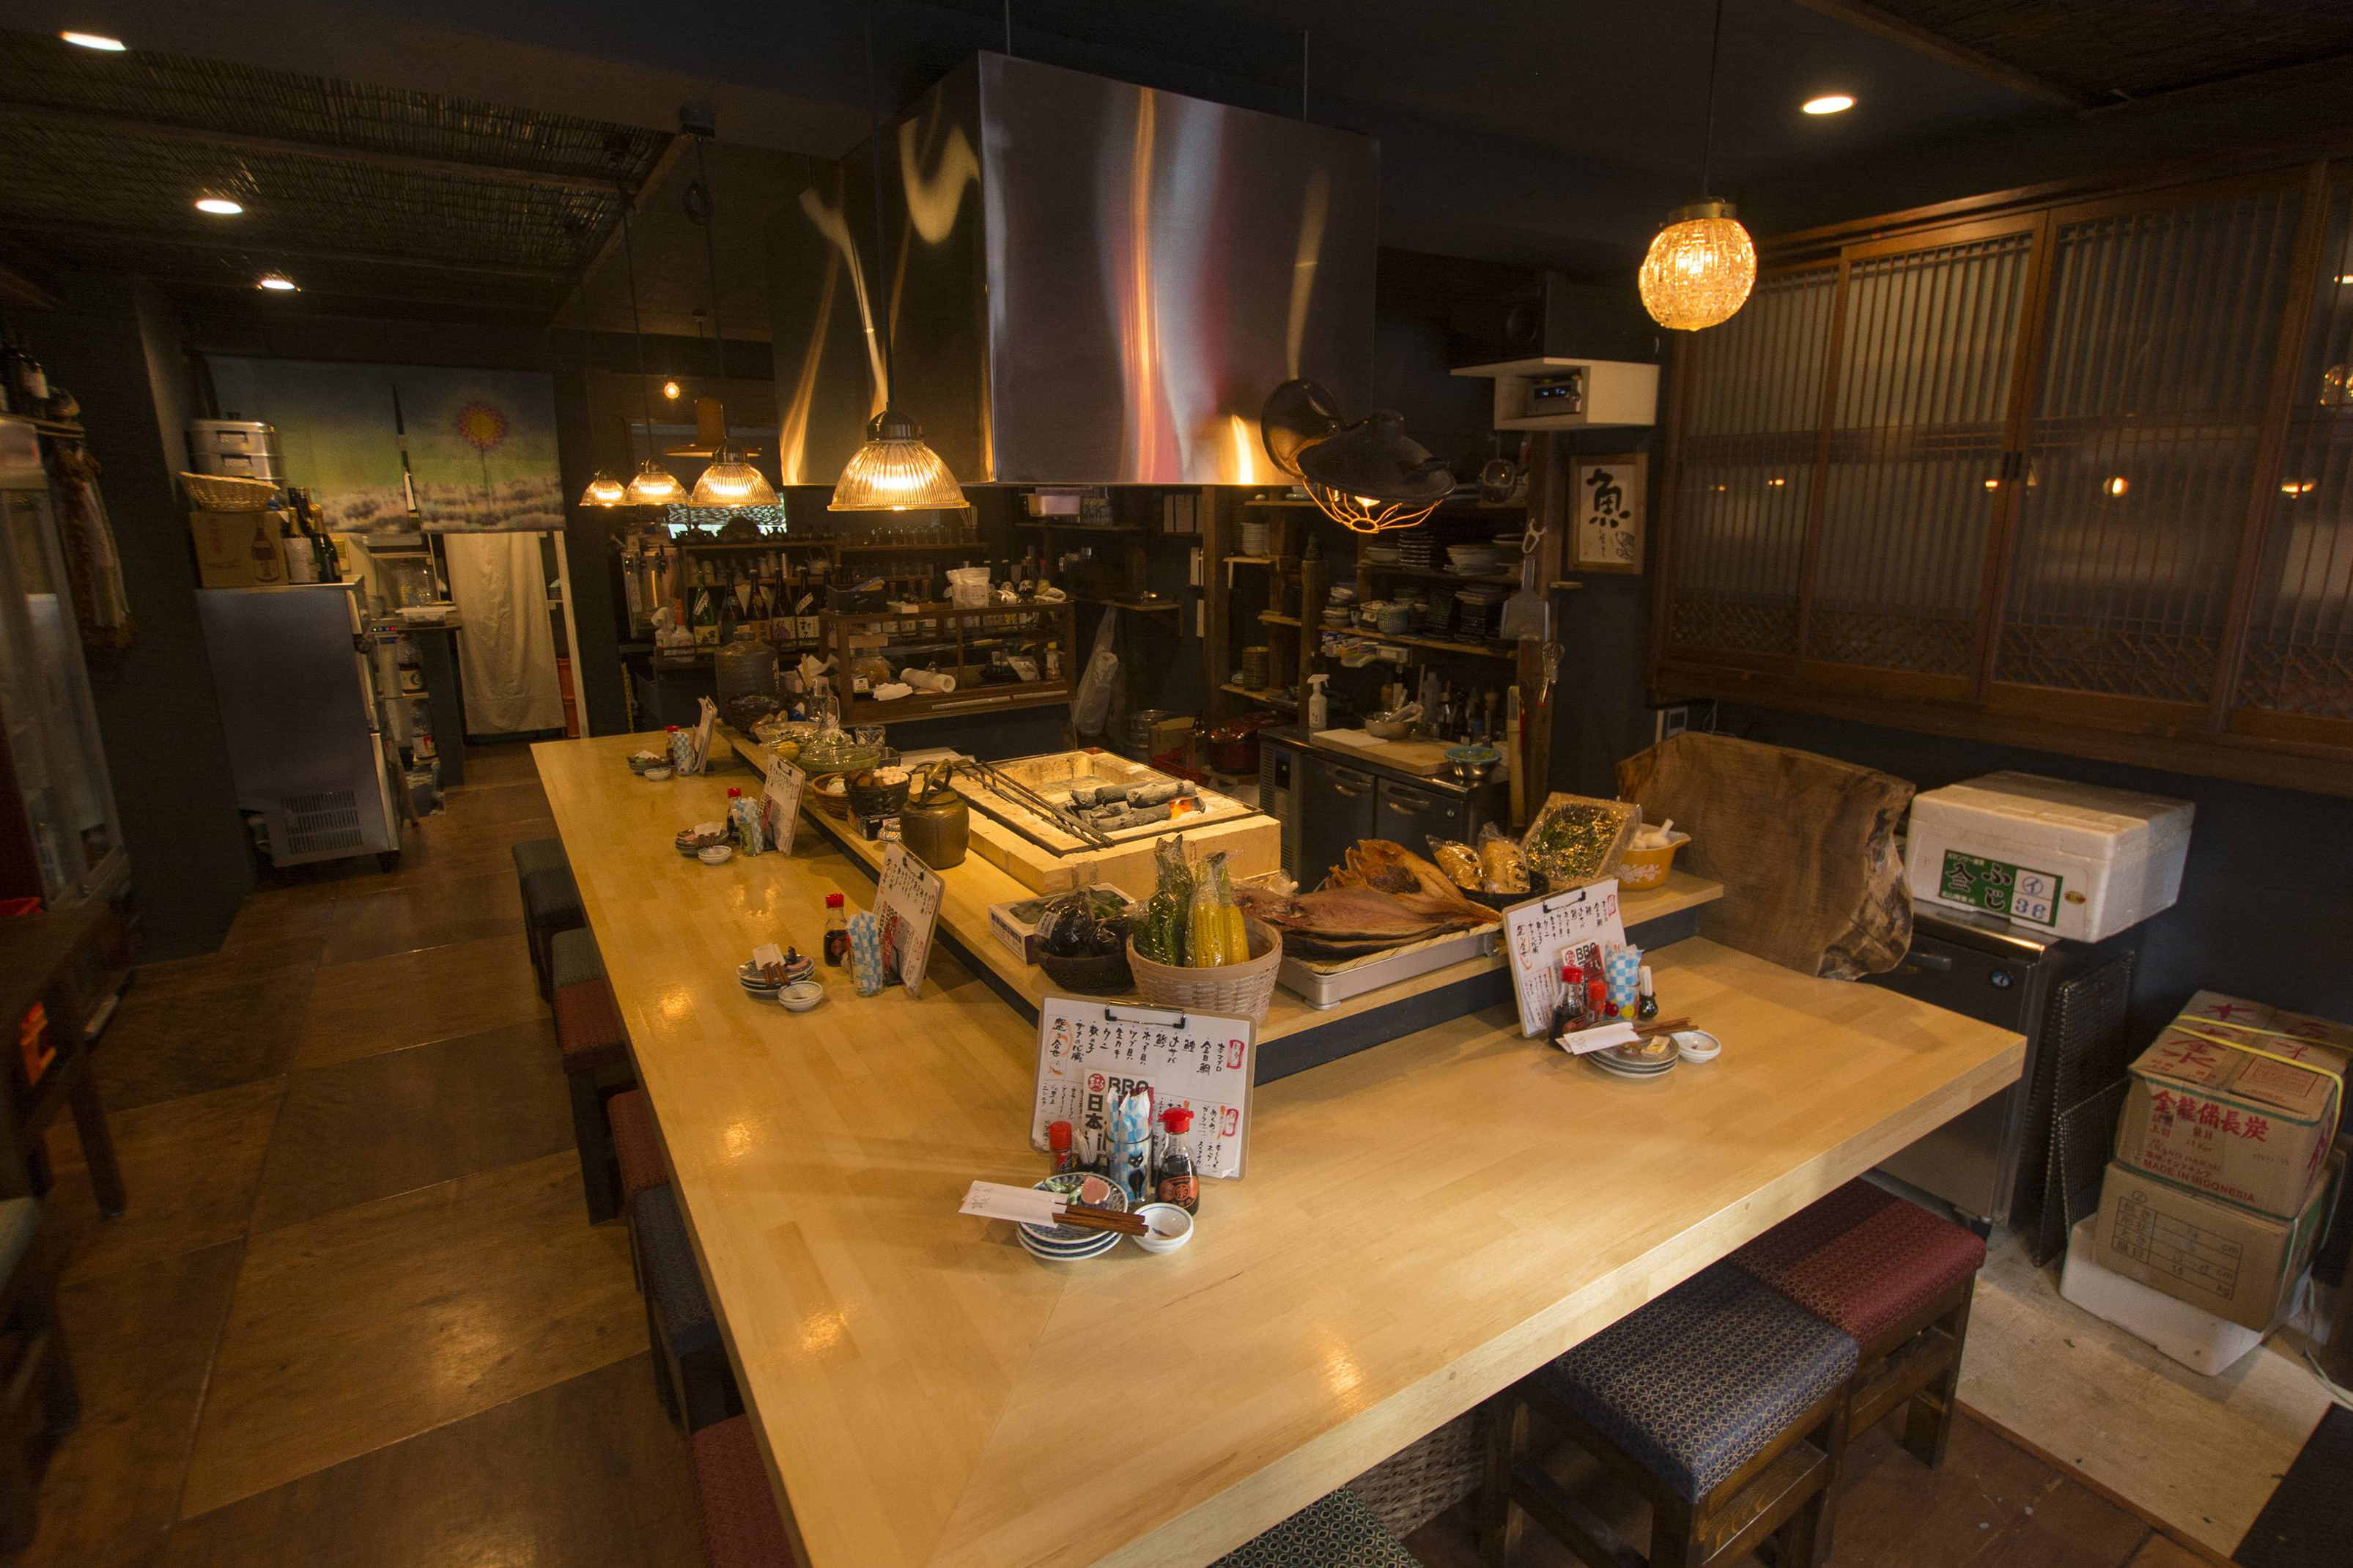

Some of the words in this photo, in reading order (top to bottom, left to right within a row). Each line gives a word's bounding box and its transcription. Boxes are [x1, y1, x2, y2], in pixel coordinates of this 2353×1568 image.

[1981, 863, 2011, 911] ふじ
[2015, 898, 2046, 920] 36
[1099, 1028, 1111, 1049] ウニ
[2142, 1158, 2176, 1176] MADE
[2176, 1170, 2190, 1181] IN
[2190, 1175, 2256, 1203] INDONESIA
